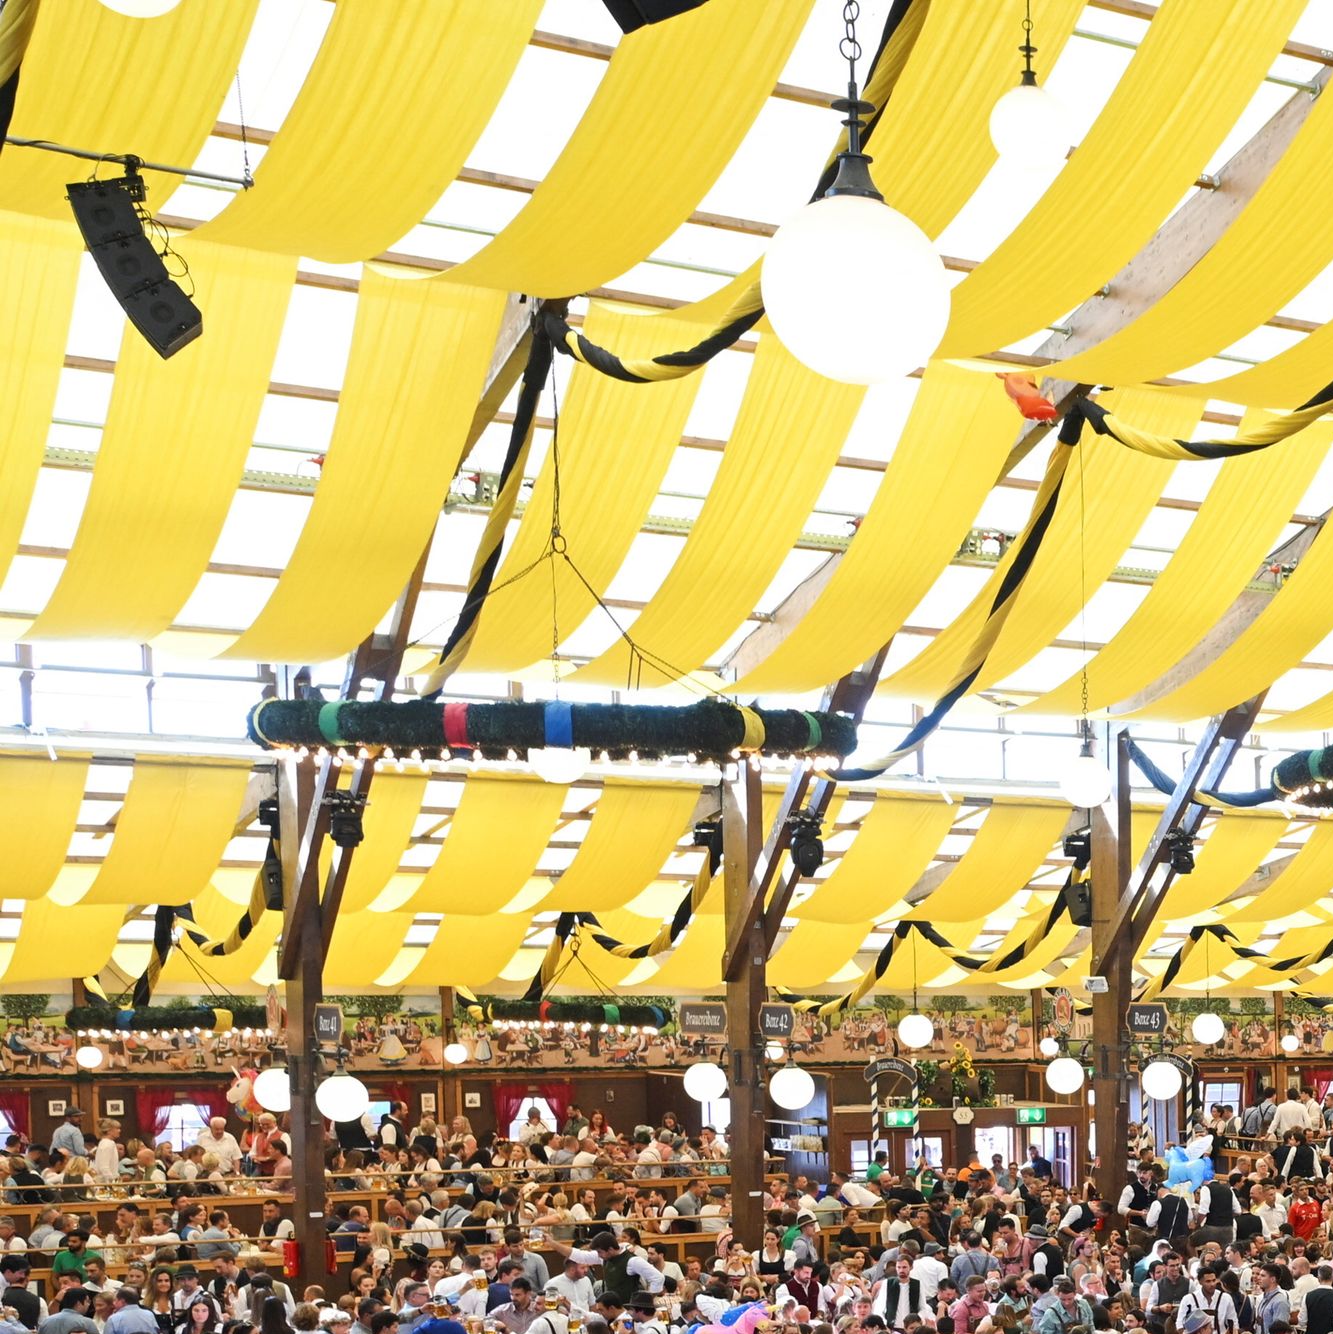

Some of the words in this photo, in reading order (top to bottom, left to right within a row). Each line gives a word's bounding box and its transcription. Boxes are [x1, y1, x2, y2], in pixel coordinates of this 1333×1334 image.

[780, 1014, 788, 1032] 42
[1134, 1012, 1150, 1026] Boxe
[1150, 1012, 1160, 1029] 43
